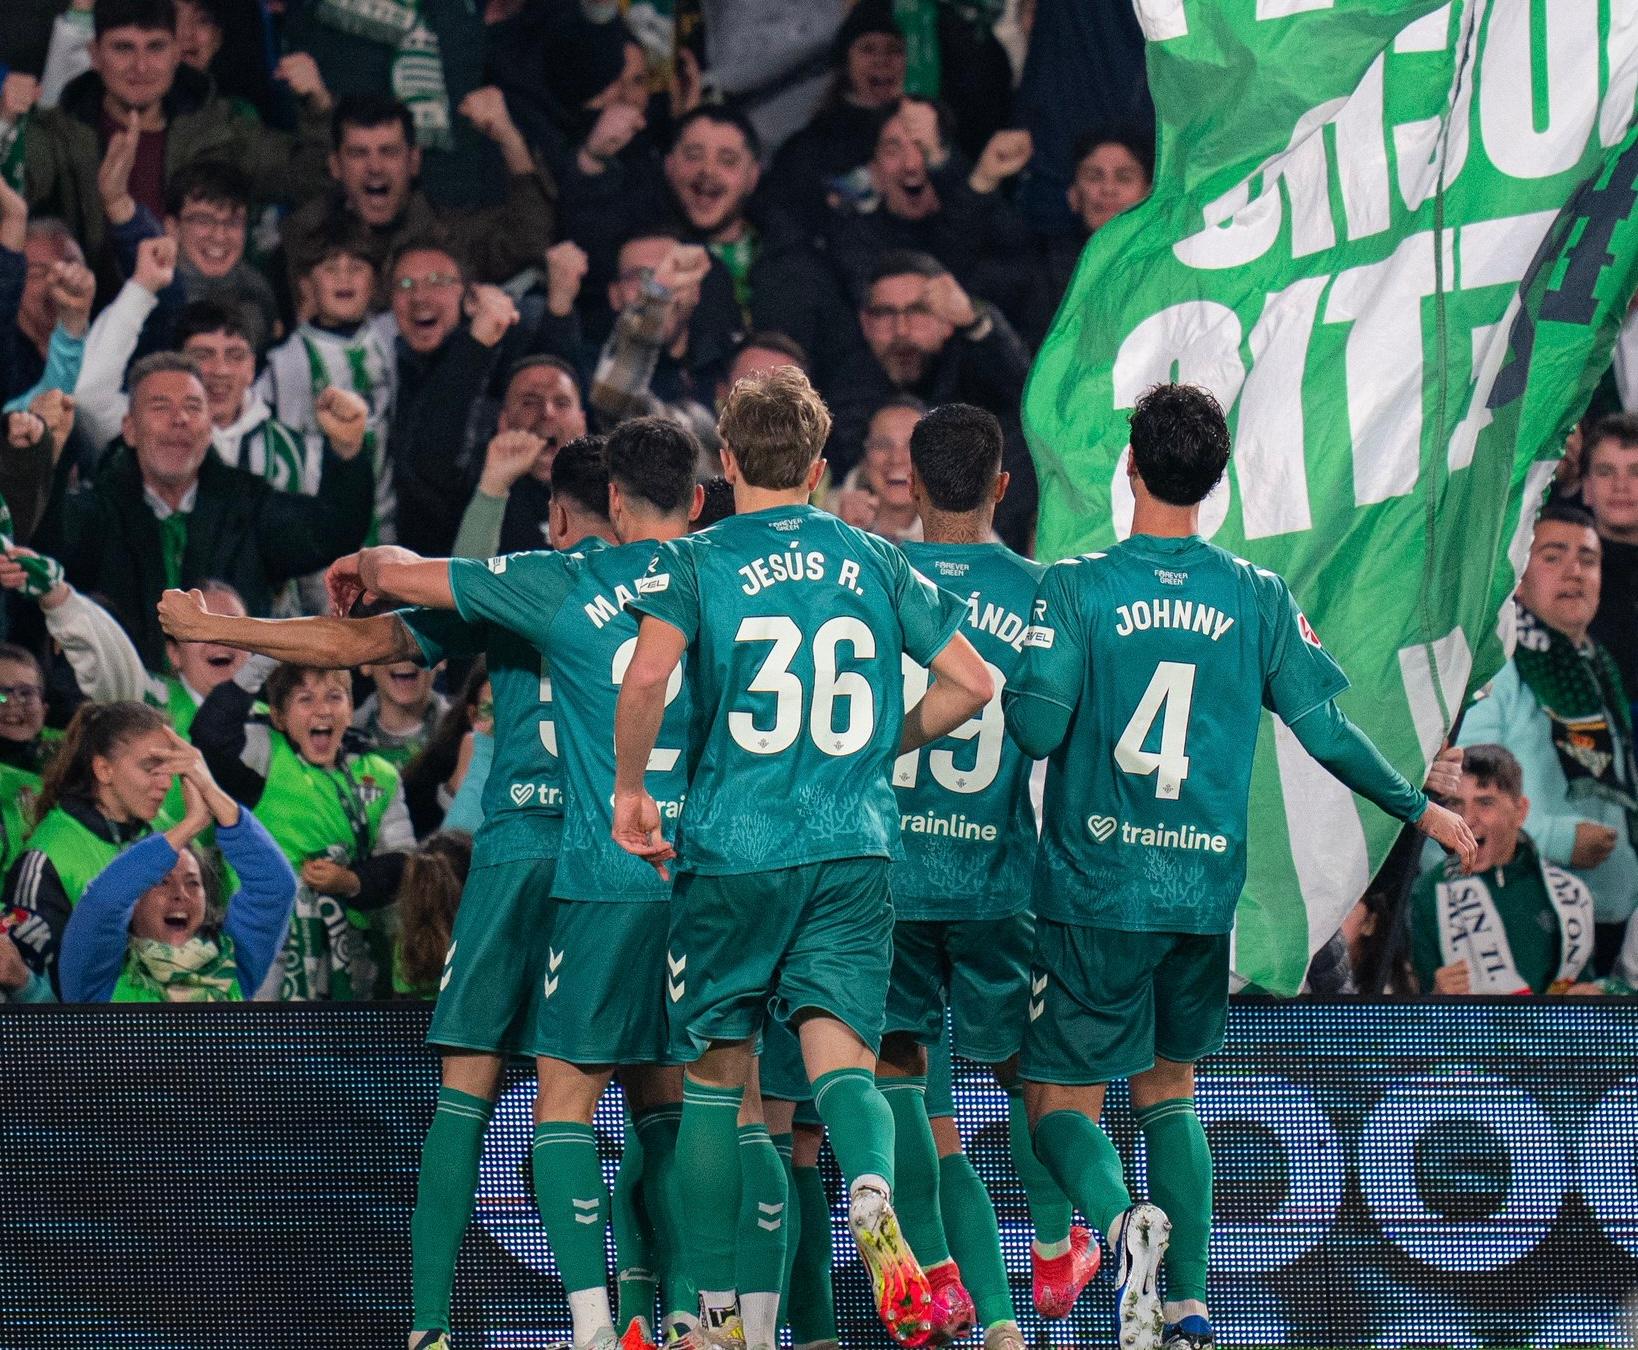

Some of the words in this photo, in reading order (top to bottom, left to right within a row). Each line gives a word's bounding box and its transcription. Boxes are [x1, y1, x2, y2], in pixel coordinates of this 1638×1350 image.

[737, 541, 826, 597] JESÚS
[837, 561, 865, 597] R.
[584, 584, 636, 630] MA
[967, 591, 1028, 653] ÁND
[1115, 599, 1235, 642] JOHNNY
[727, 615, 877, 757] 36
[1114, 661, 1197, 801] 4
[538, 783, 563, 805] tr
[899, 811, 998, 841] rainline
[1122, 823, 1228, 854] trainline
